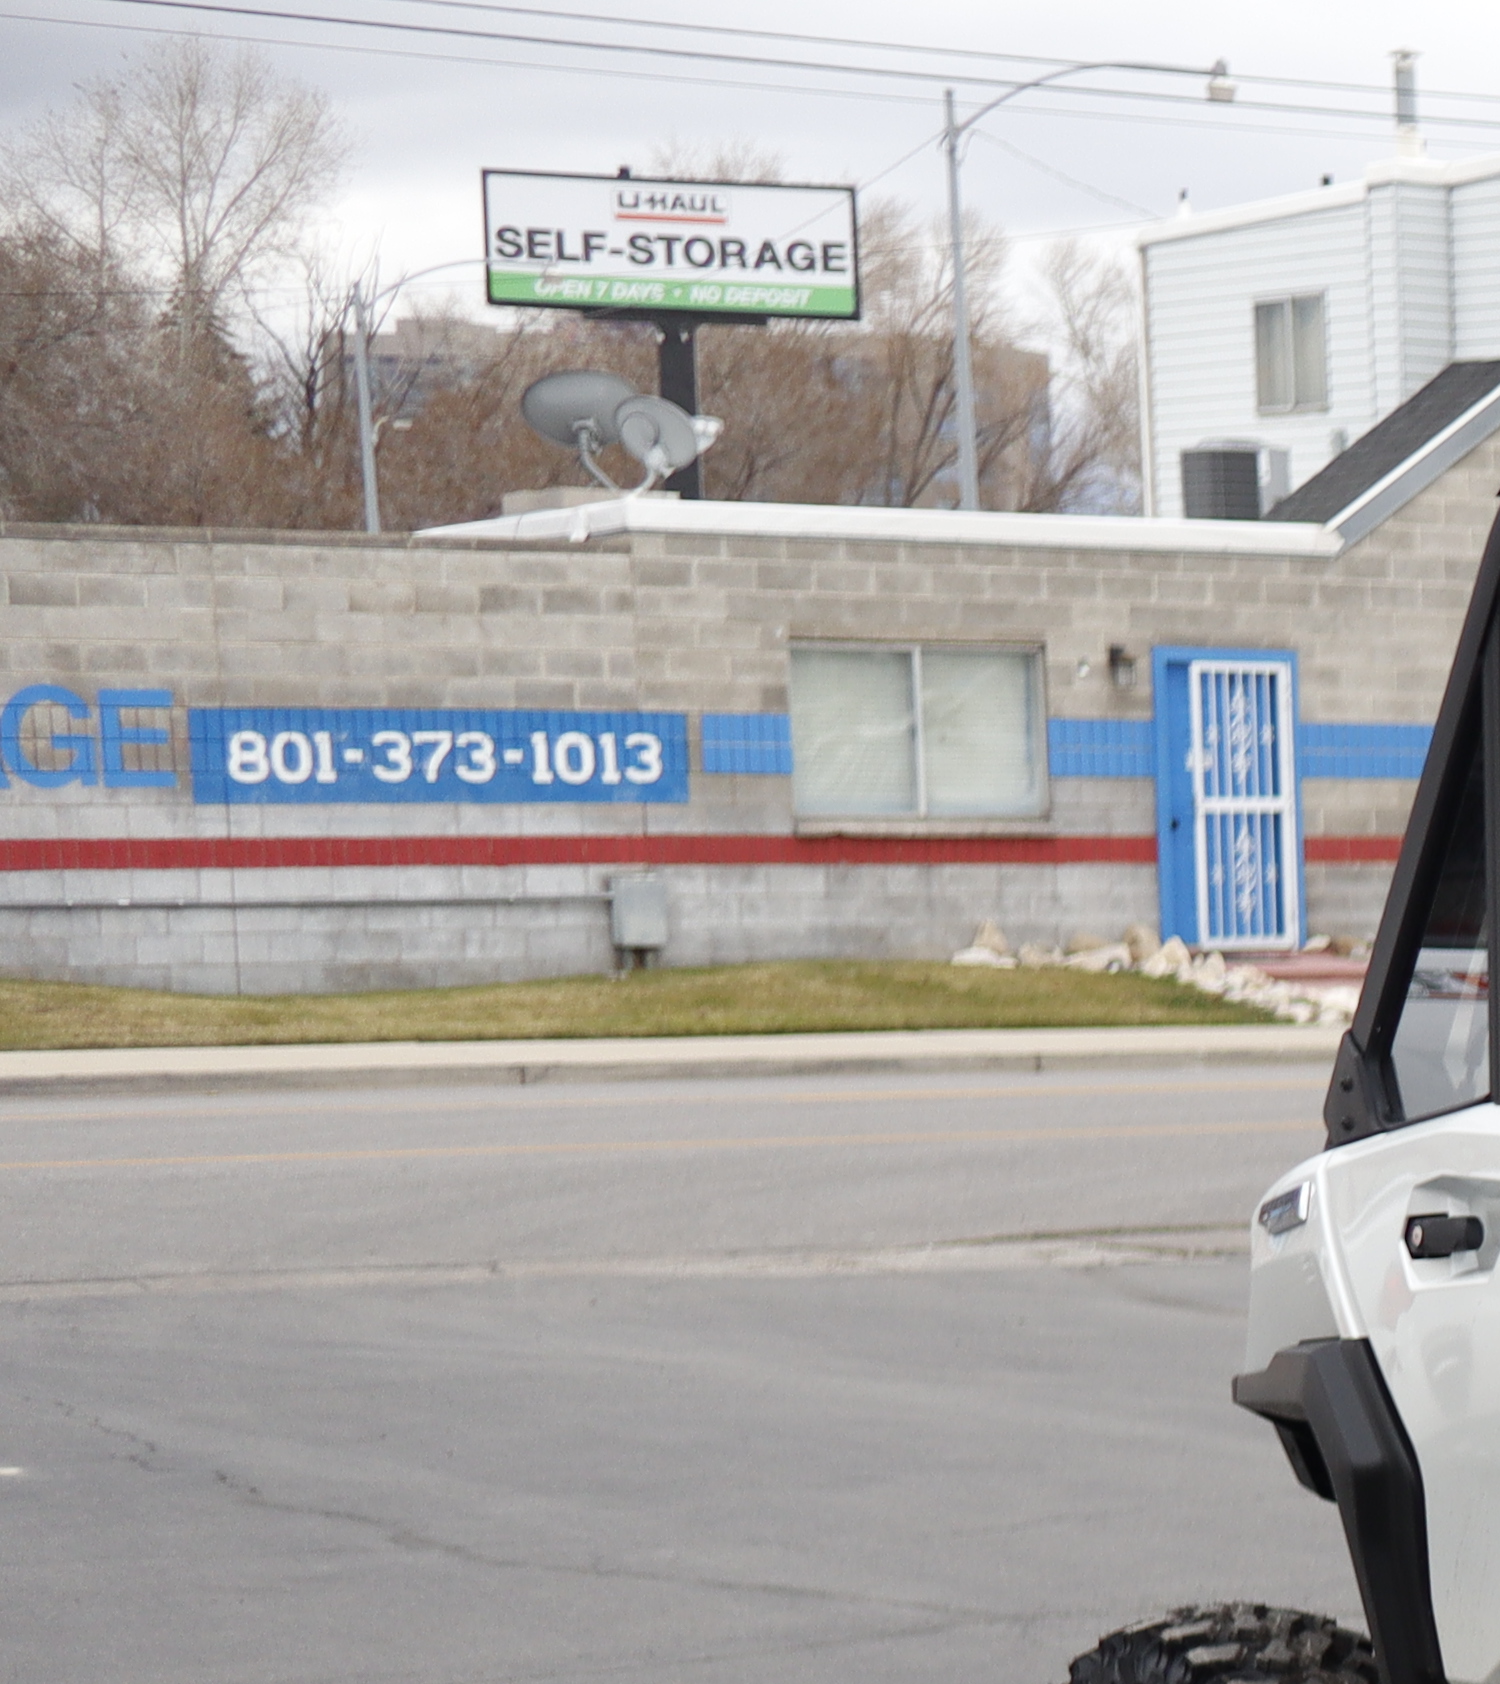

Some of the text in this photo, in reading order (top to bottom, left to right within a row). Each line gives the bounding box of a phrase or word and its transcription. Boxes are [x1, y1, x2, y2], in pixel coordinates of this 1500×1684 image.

[495, 226, 847, 273] SELF-STORAGE
[534, 278, 815, 308] OPEN 7 DAYS NO DEPOSIT
[0, 684, 177, 789] GE
[226, 729, 664, 786] 801-373-1013
